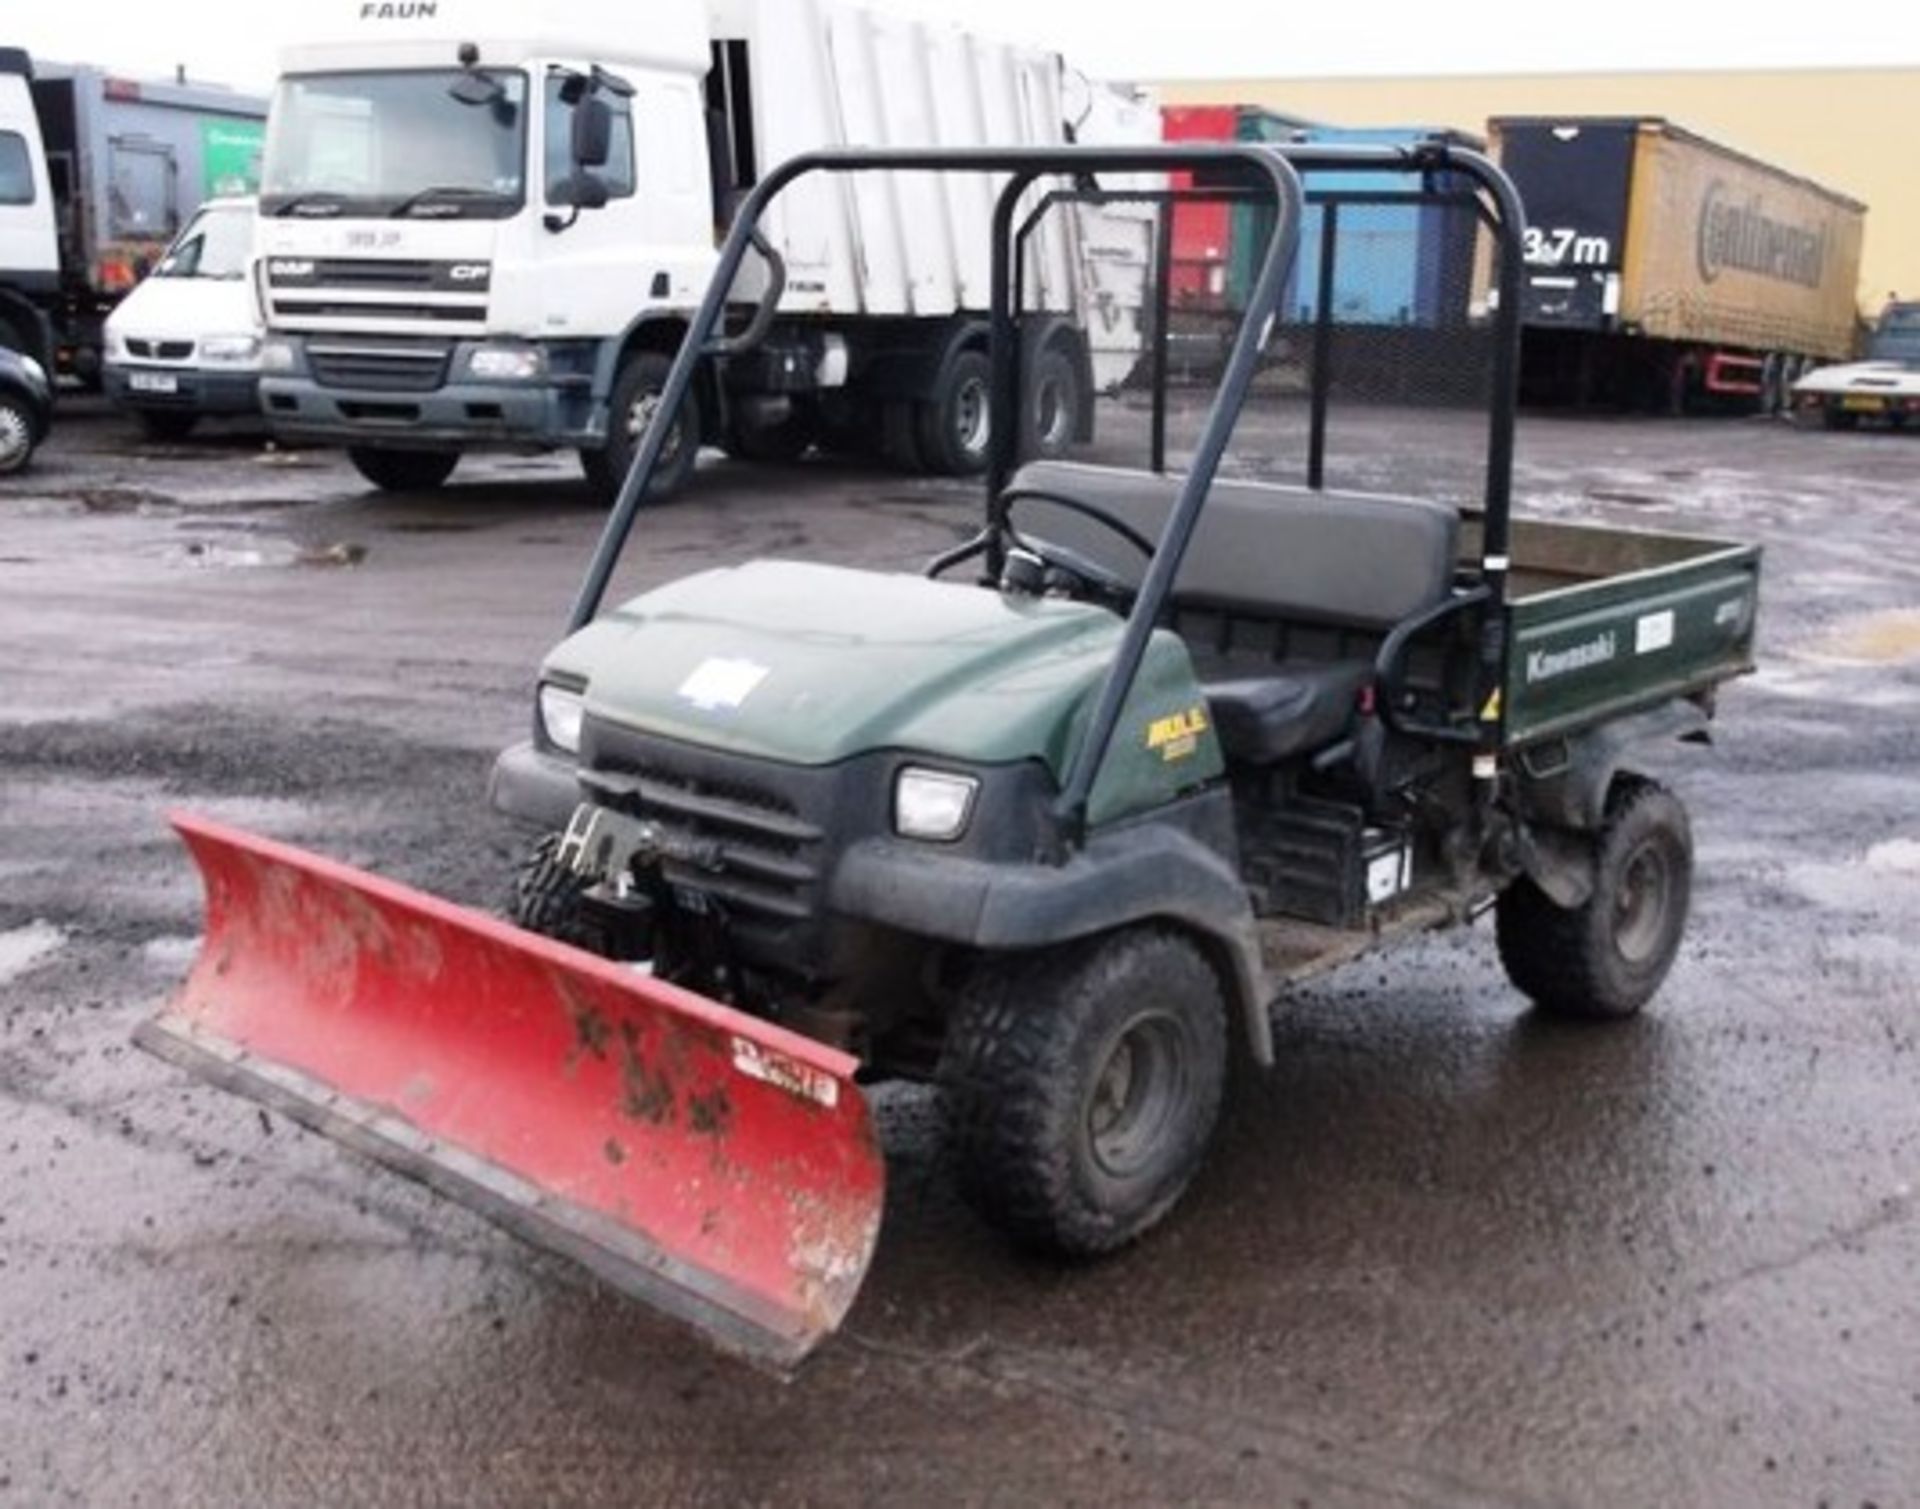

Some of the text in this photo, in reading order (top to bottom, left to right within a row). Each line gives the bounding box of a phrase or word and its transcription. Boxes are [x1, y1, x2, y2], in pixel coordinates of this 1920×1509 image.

[360, 2, 437, 19] FAUN
[1697, 177, 1826, 286] Continental
[450, 265, 494, 279] CF
[1526, 629, 1615, 684] Kawasaki
[1147, 709, 1206, 748] MULE
